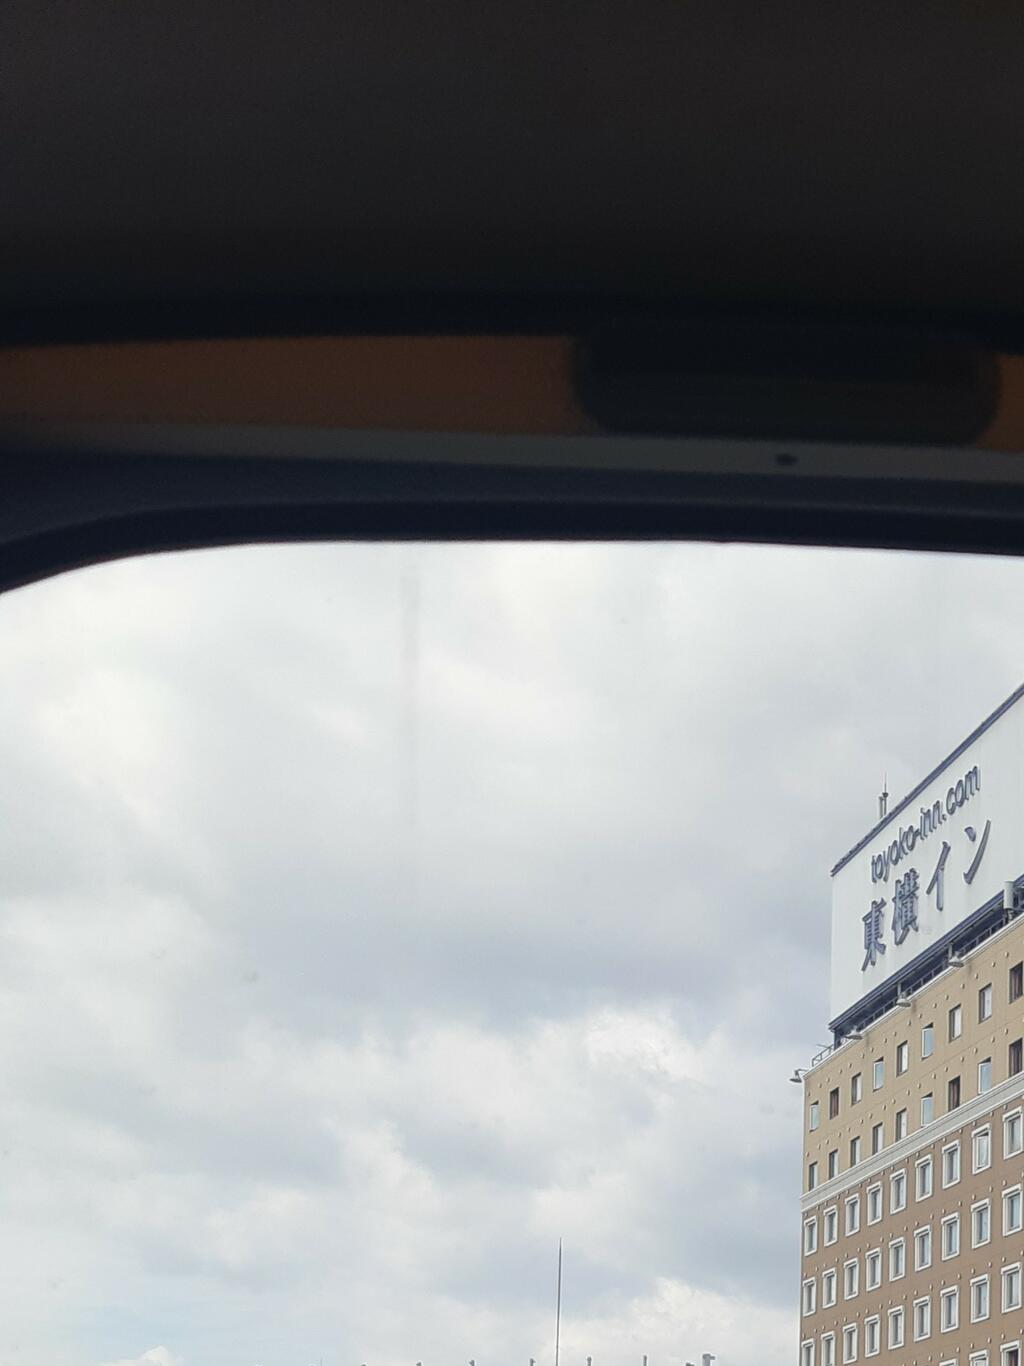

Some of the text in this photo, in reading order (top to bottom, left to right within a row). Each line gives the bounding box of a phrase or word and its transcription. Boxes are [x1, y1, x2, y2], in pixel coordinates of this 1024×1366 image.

[870, 764, 982, 884] toyoko-inn.com
[861, 818, 992, 973] 東横イン
